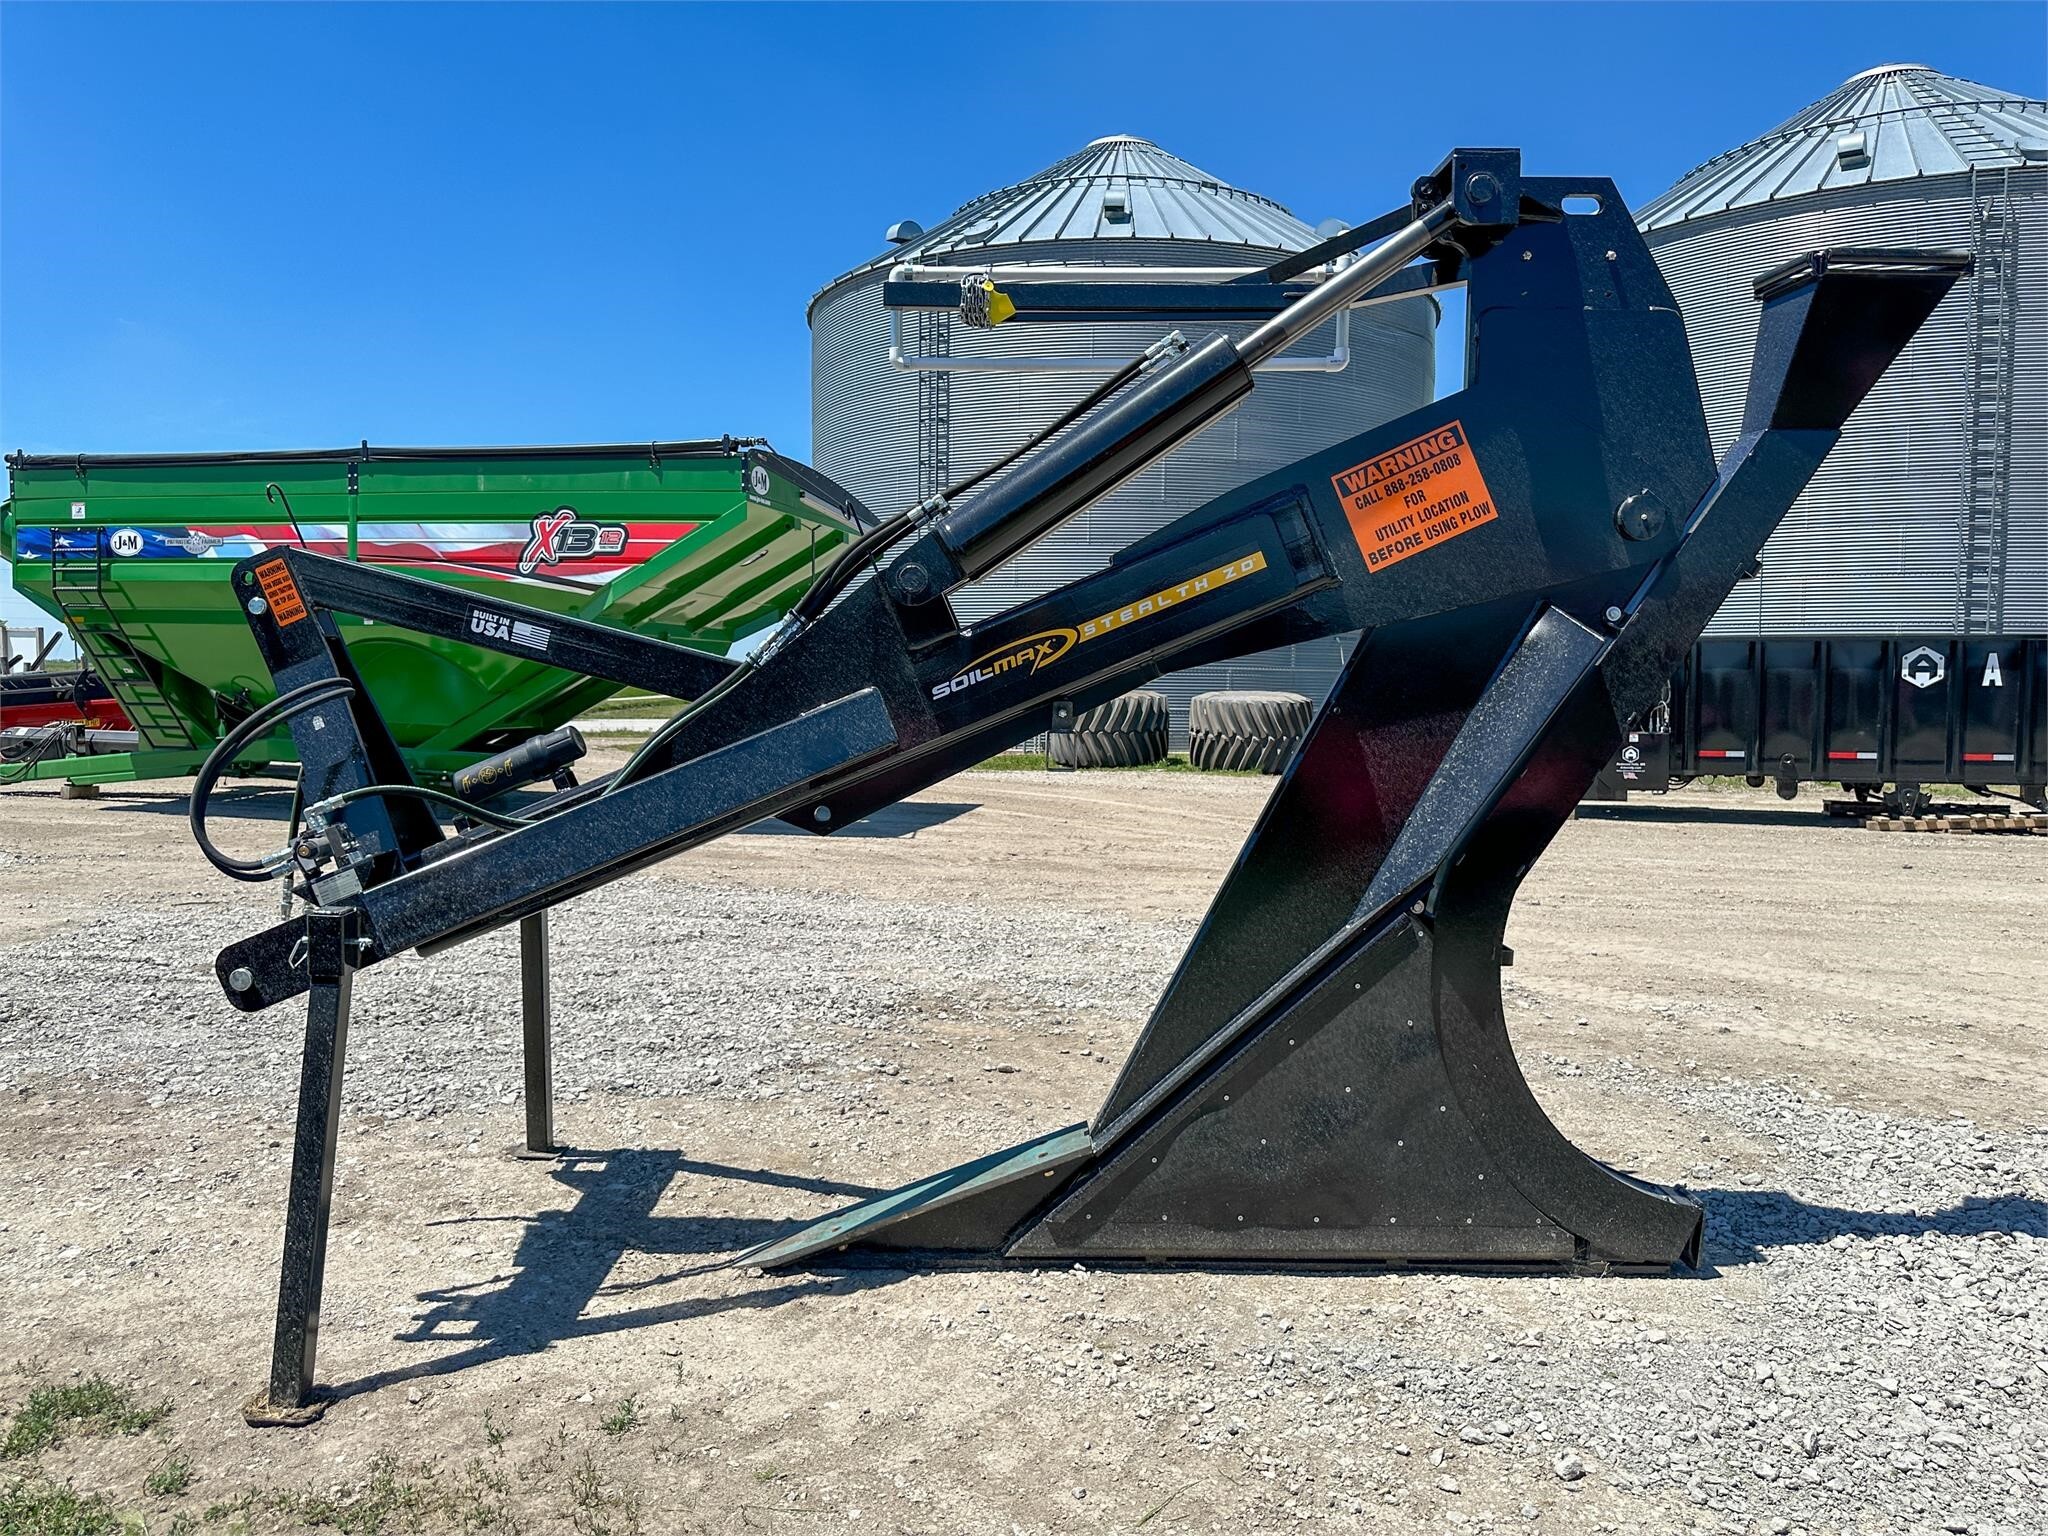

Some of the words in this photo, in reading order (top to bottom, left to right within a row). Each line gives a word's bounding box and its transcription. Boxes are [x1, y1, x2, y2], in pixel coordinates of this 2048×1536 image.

[1343, 431, 1458, 493] WARNING
[1355, 489, 1383, 510] CALL
[1384, 453, 1461, 497] 888-258-0808
[1403, 489, 1427, 509] FOR
[1375, 514, 1415, 542] UTILITY
[1417, 490, 1470, 523] LOCATION
[114, 535, 138, 550] J&M
[522, 512, 599, 568] X13
[599, 530, 621, 544] 12
[1368, 532, 1424, 565] BEFORE
[1424, 517, 1459, 540] USING
[1459, 501, 1491, 525] PLOW
[258, 562, 286, 578] WARNING
[277, 605, 305, 622] WARNING
[472, 609, 499, 622] BUILT
[499, 616, 510, 626] IN
[1084, 576, 1209, 635] STEALTH
[470, 617, 510, 641] USA
[931, 639, 1055, 700] SOIL-MAX
[1982, 653, 2003, 686] A
